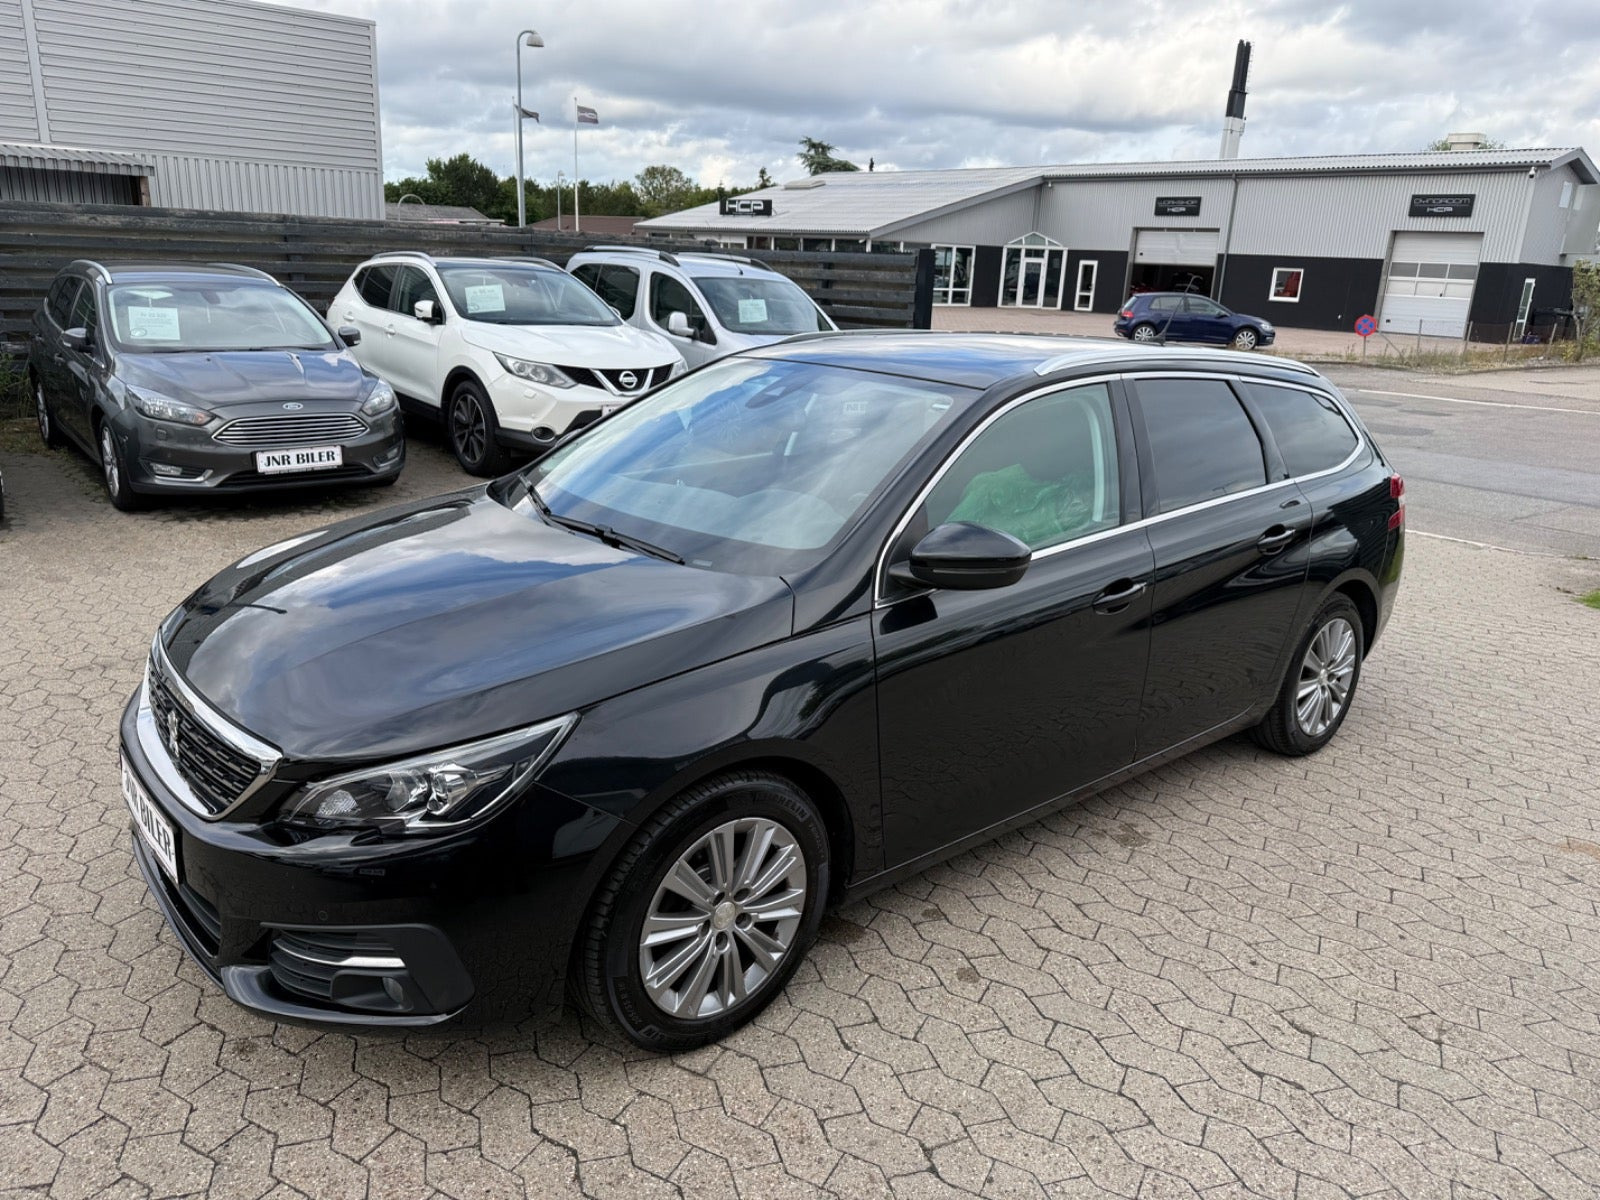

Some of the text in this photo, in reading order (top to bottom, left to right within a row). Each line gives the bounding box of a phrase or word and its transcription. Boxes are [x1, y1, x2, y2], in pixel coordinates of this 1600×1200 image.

[725, 199, 764, 213] HCP
[264, 450, 336, 468] JNR BILER
[139, 795, 173, 862] BILER
